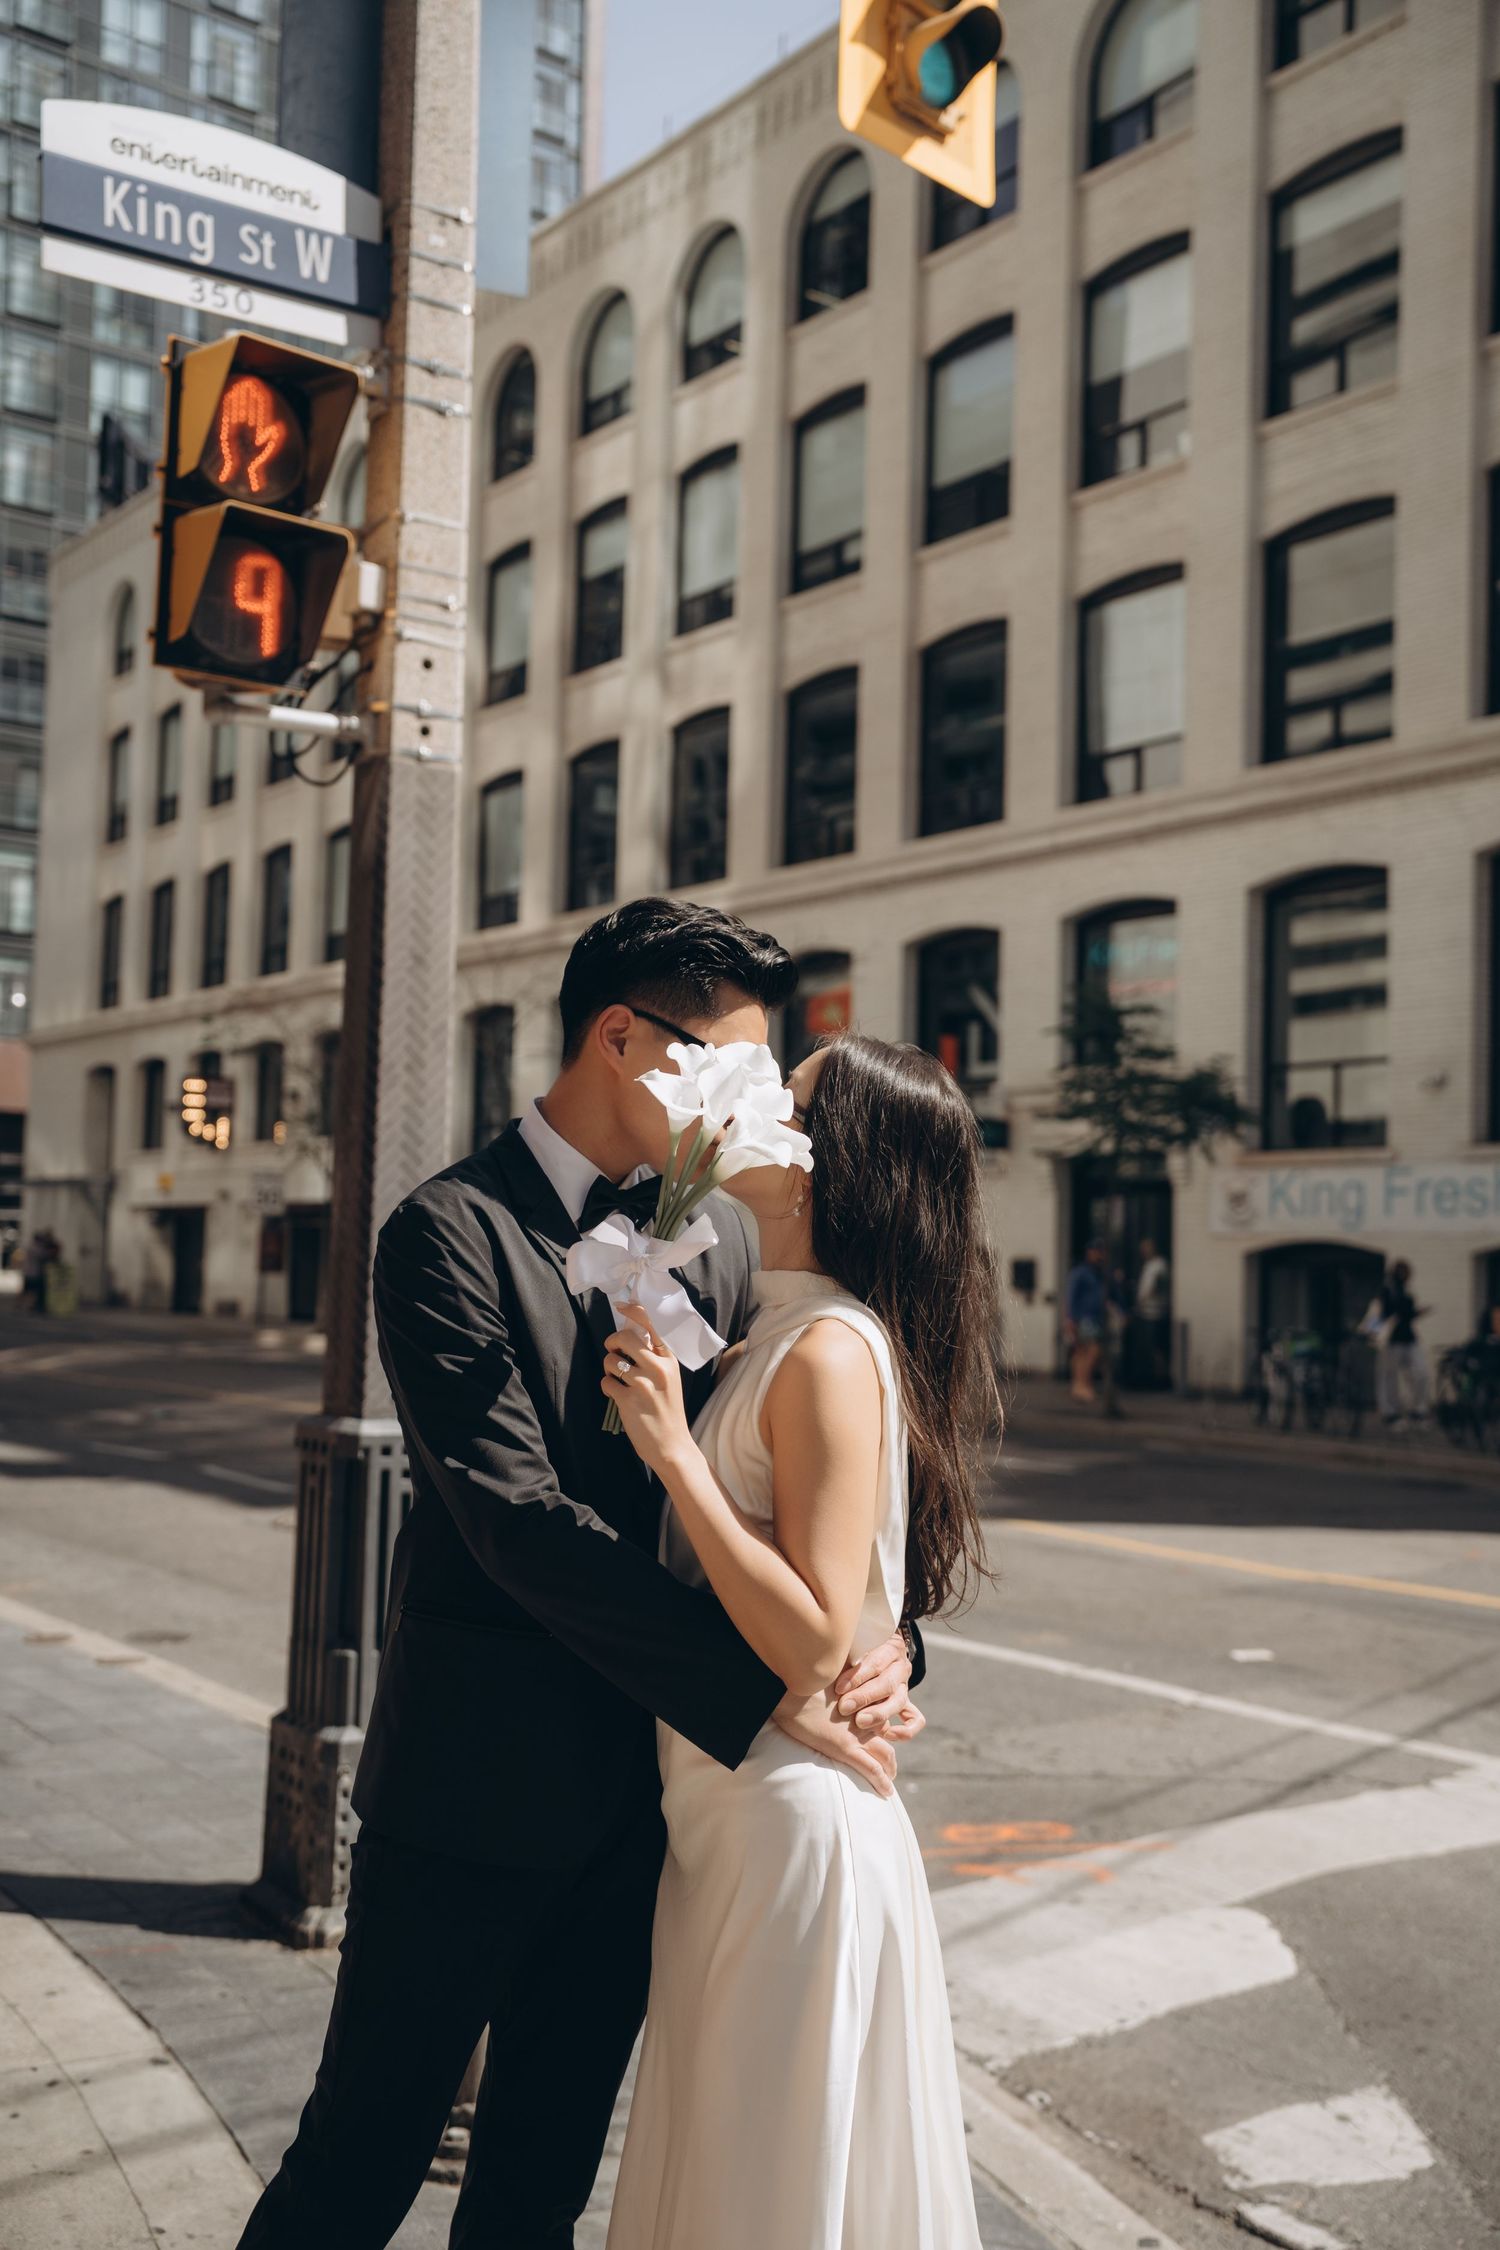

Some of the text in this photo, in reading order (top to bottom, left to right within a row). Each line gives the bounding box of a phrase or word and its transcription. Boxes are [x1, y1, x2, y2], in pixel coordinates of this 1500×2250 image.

[111, 137, 319, 211] entertainment
[102, 175, 334, 284] King St W
[189, 278, 254, 316] 350
[234, 553, 283, 659] 9
[1267, 1168, 1367, 1232] King
